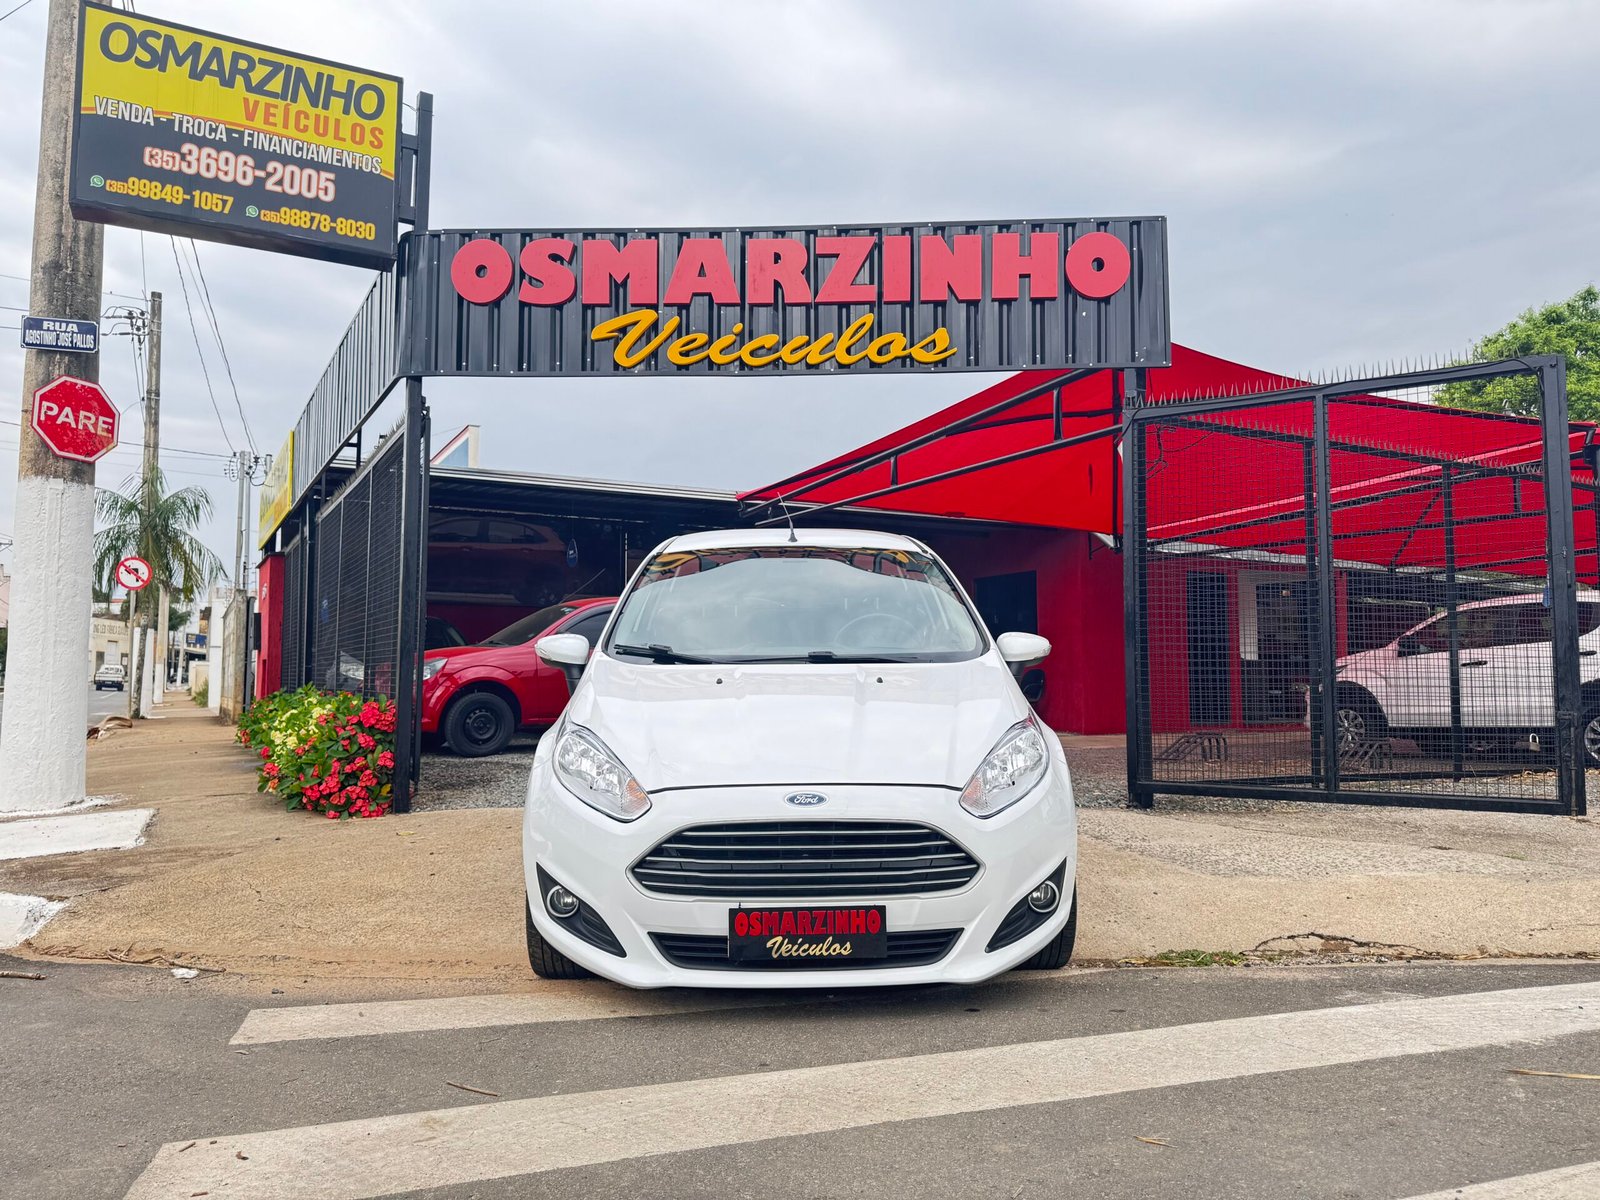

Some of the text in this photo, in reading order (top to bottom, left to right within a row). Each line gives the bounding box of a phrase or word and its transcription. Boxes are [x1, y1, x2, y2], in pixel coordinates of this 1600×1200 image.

[99, 21, 386, 121] OSMARZINHO
[94, 95, 155, 127] VENDA
[172, 112, 228, 142] TROCA
[243, 128, 382, 175] FINANCIAMENTOS
[242, 96, 384, 150] VEÍCULOS
[143, 142, 337, 203] (35)3696-2005
[450, 230, 1132, 306] OSMARZINHO
[25, 330, 56, 345] AGOSTINHO
[43, 321, 78, 332] RUA
[39, 400, 113, 438] PARE
[794, 793, 819, 804] Ford
[734, 909, 881, 937] OSMARZINHO
